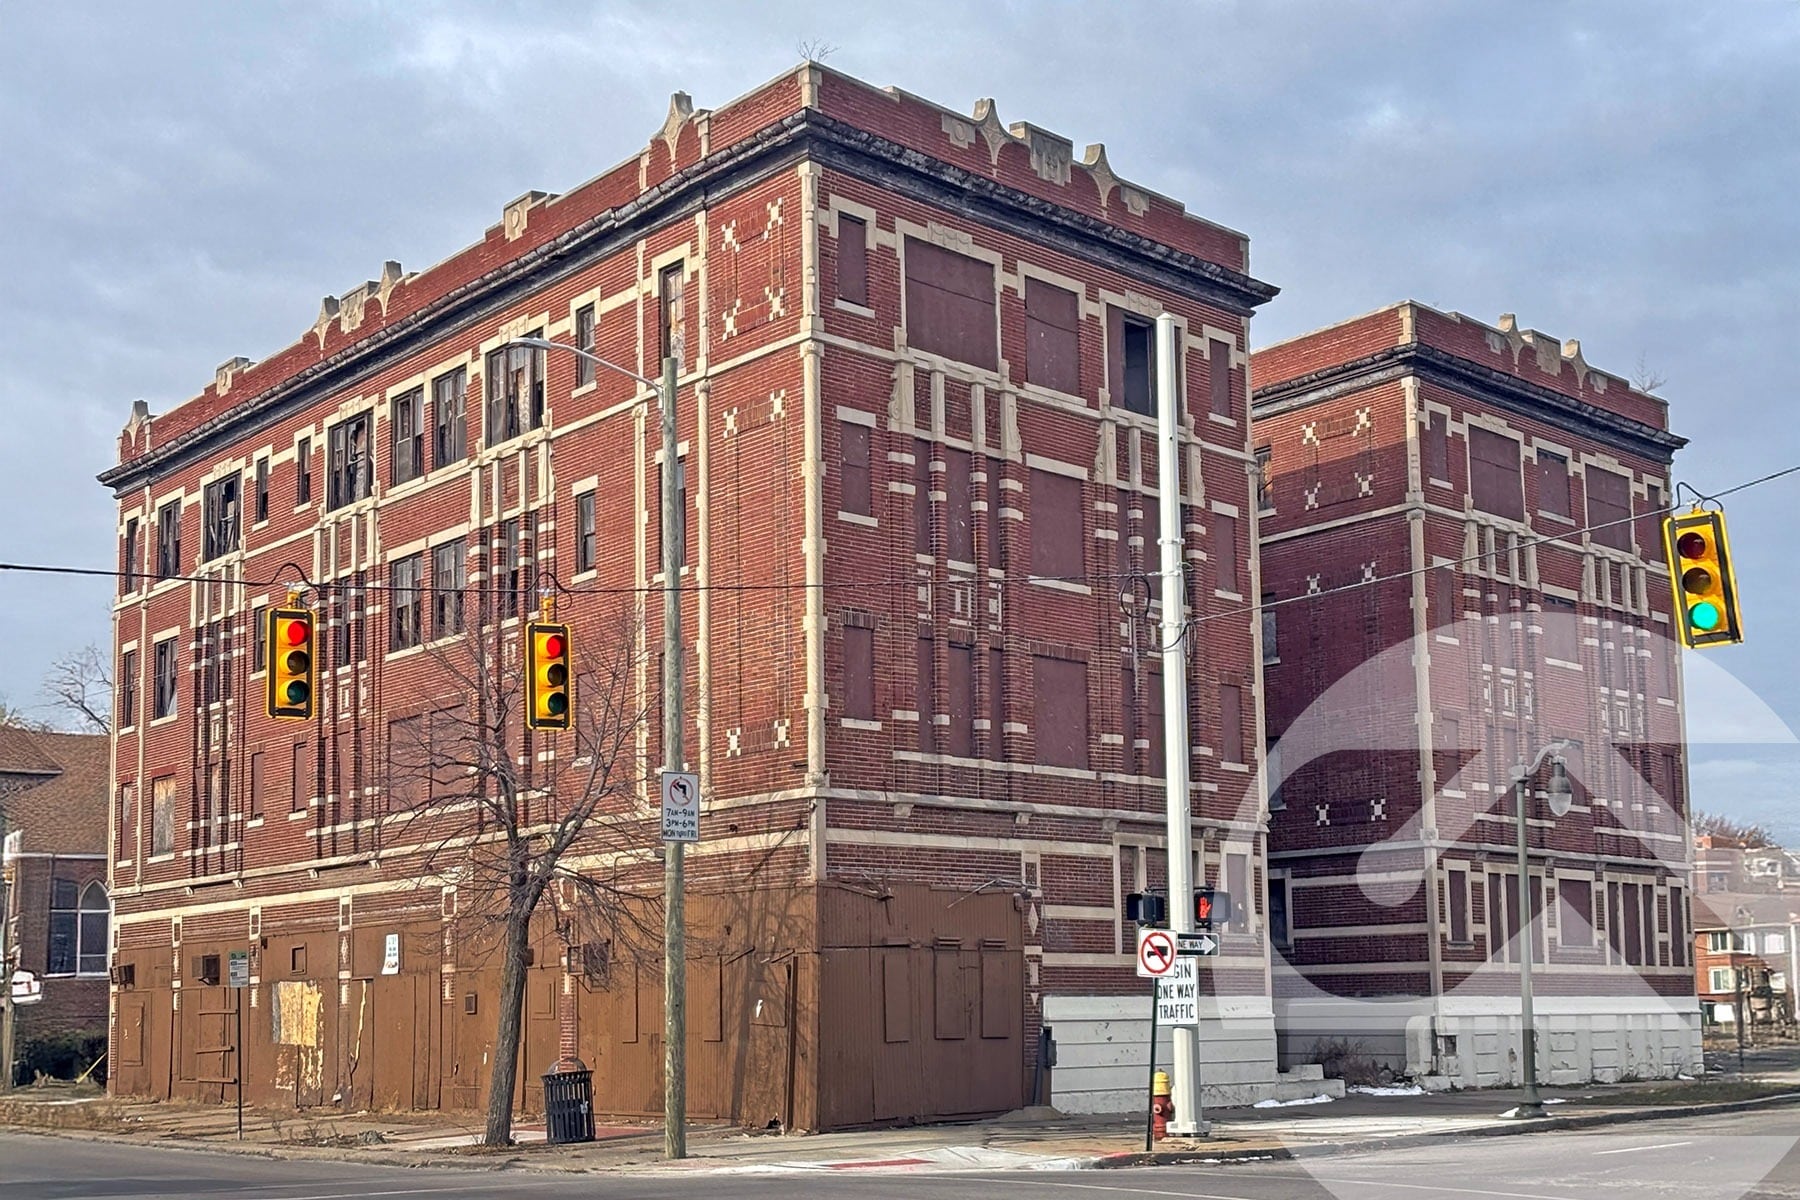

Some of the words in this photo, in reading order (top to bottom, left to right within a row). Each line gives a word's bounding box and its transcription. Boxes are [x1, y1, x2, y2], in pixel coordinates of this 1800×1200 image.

[1178, 941, 1187, 949] NE
[1190, 941, 1203, 949] WAY
[1174, 964, 1192, 978] GIN
[1158, 985, 1174, 999] ONE
[1177, 984, 1195, 998] WAY
[1159, 1004, 1194, 1019] TRAFFIC
